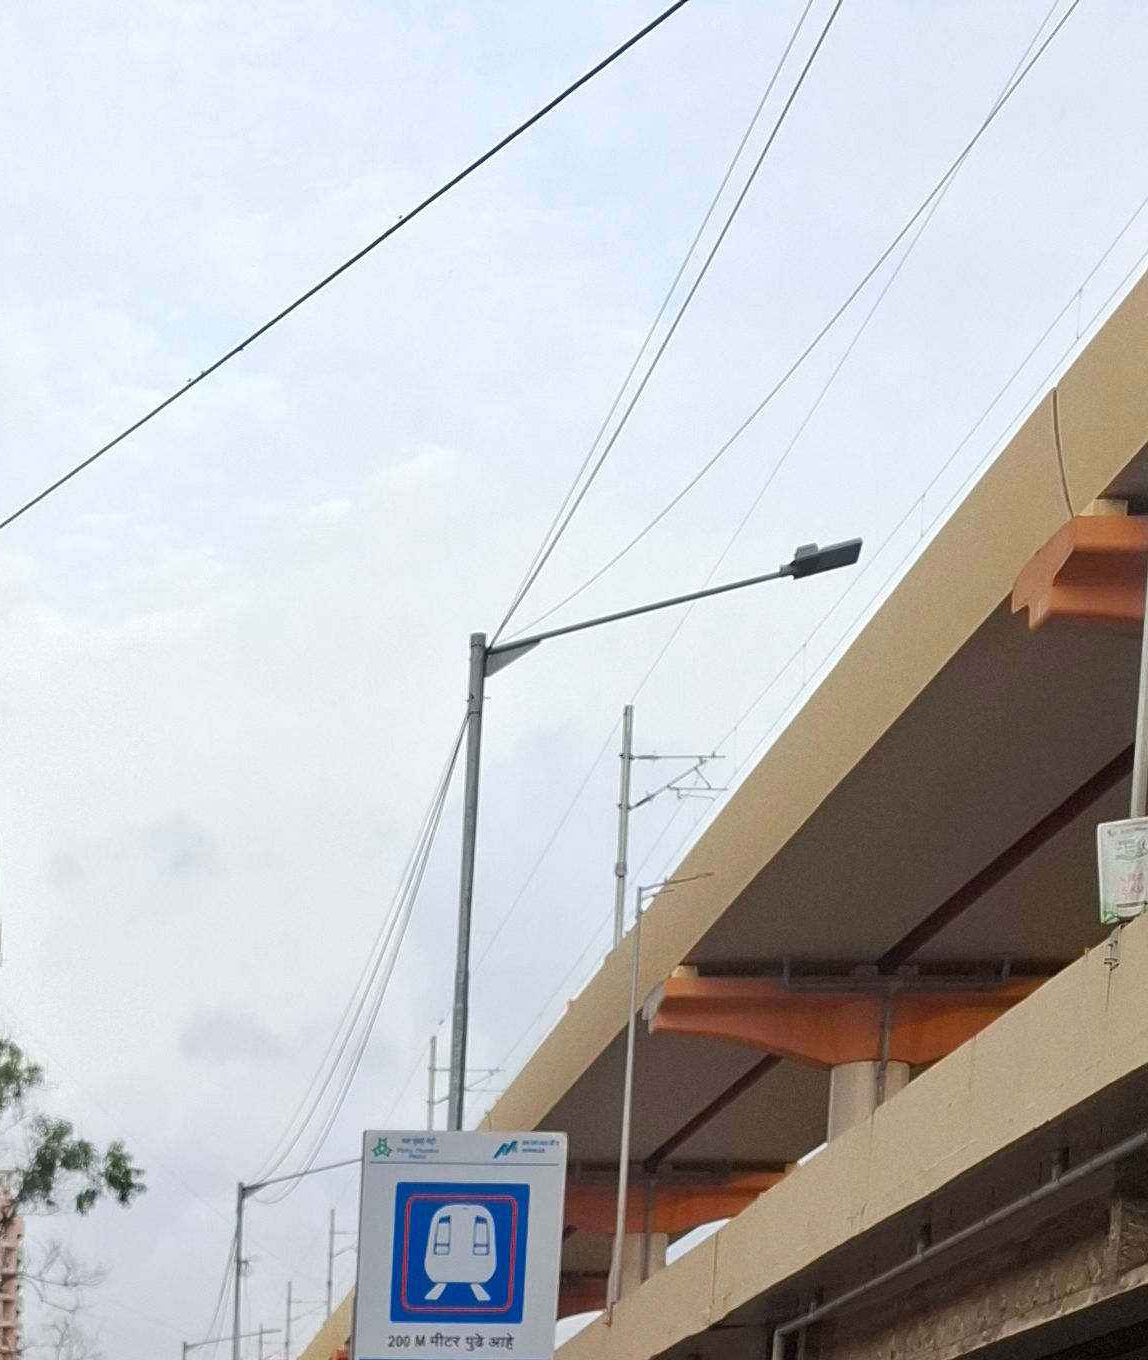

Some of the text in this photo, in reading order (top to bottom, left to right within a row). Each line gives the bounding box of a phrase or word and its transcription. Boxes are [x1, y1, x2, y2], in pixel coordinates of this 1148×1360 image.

[388, 1332, 515, 1351] 200 M मीटर पुढे आहे
